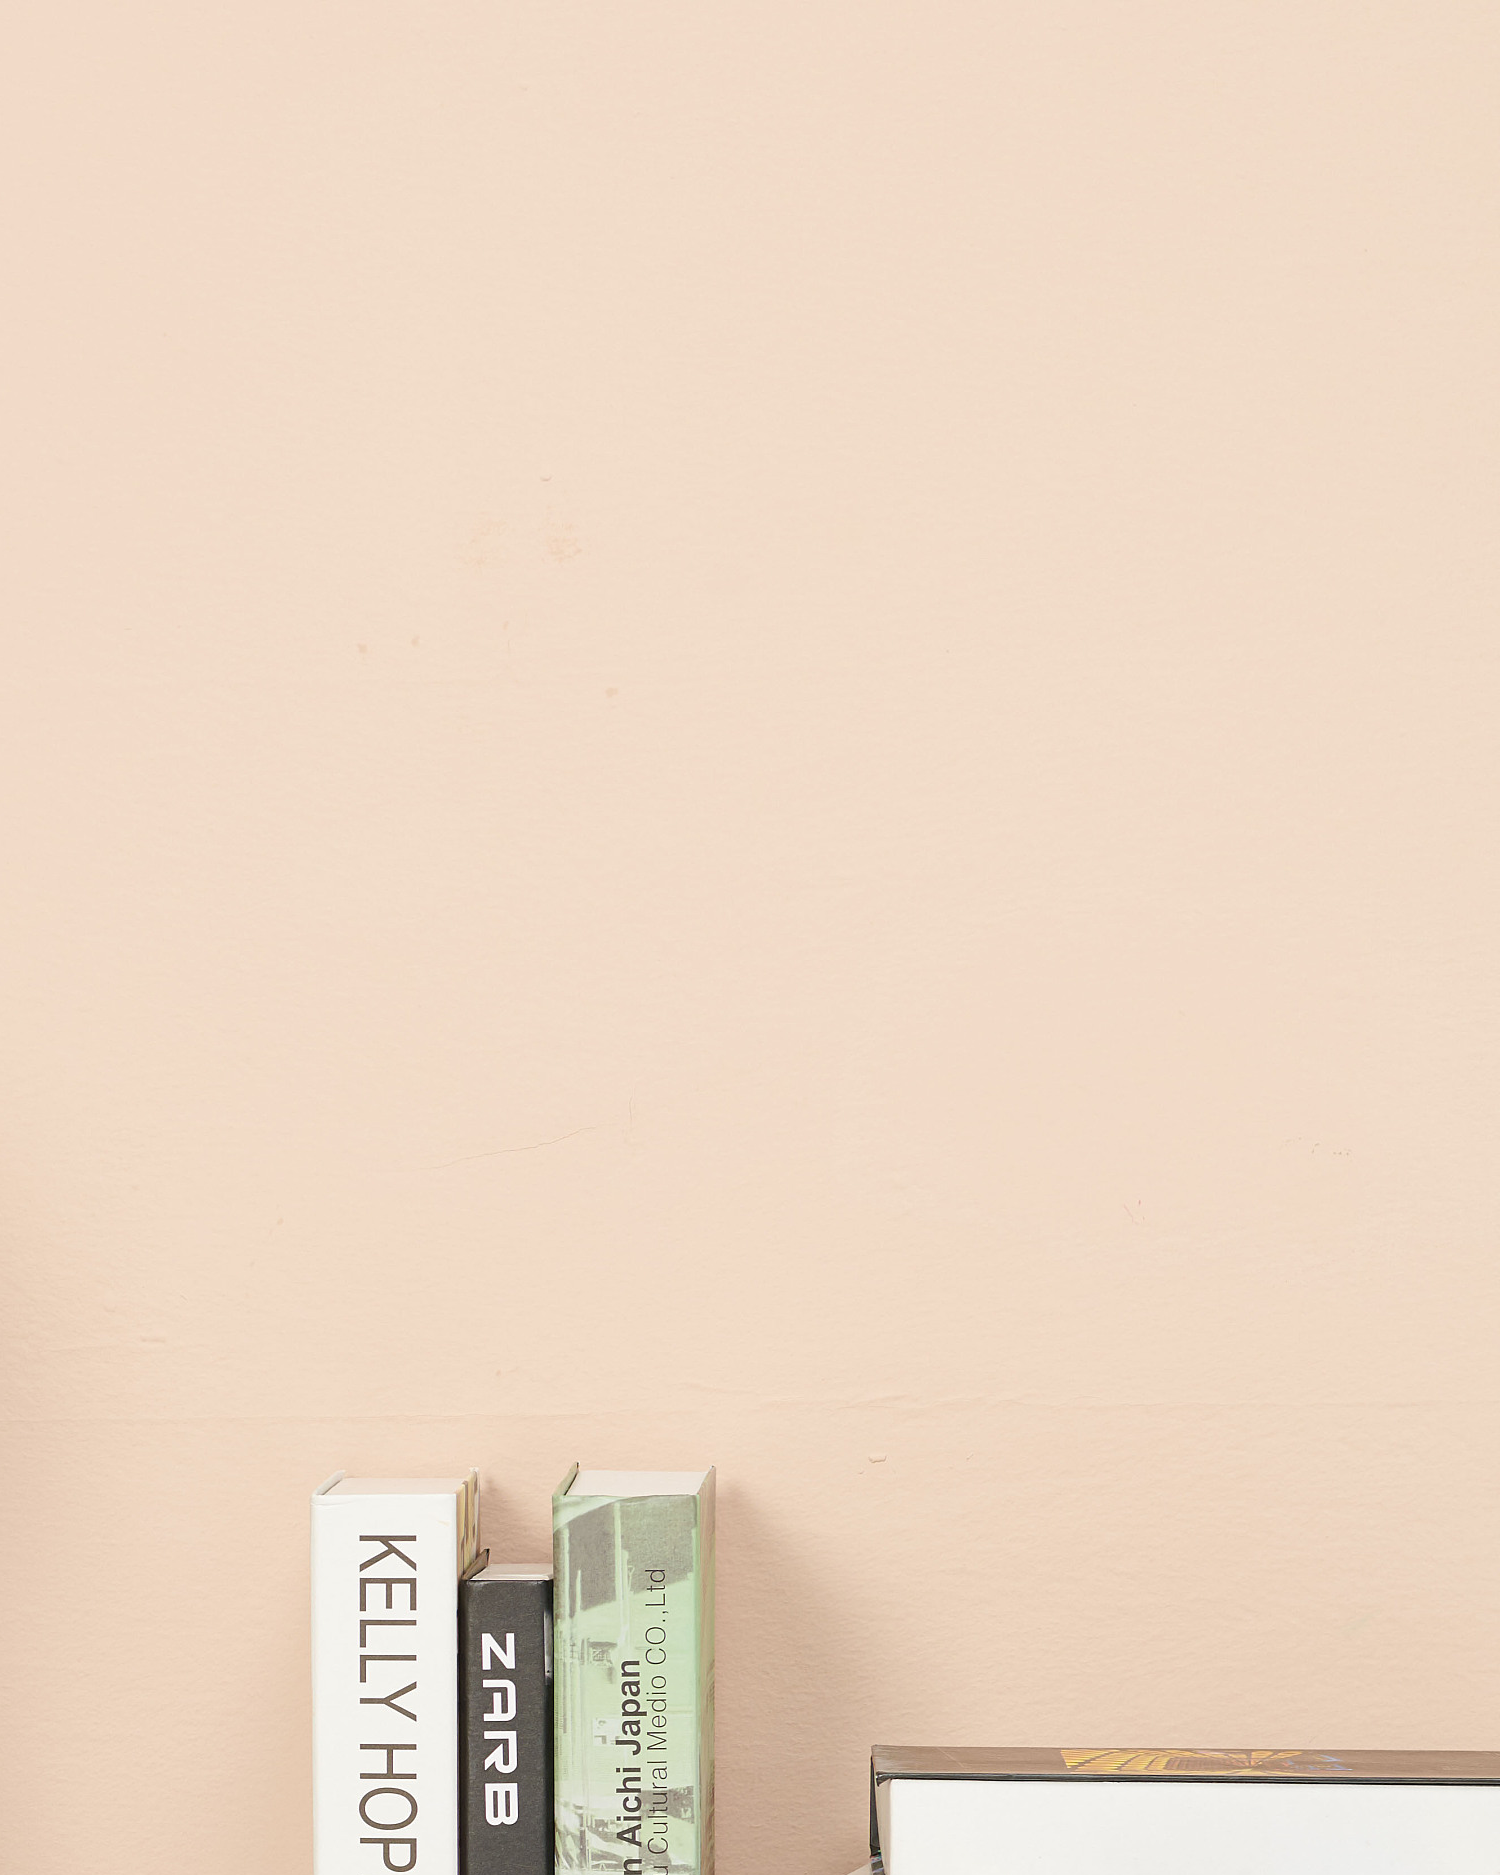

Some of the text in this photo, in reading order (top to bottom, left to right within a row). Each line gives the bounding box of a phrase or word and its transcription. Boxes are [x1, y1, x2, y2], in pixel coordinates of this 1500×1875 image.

[359, 1535, 417, 1721] KELLY
[481, 1632, 519, 1826] ZARB
[615, 1660, 648, 1756] Japan
[646, 1675, 667, 1751] Medio
[615, 1767, 642, 1847] Aichi
[647, 1760, 669, 1855] Cultural
